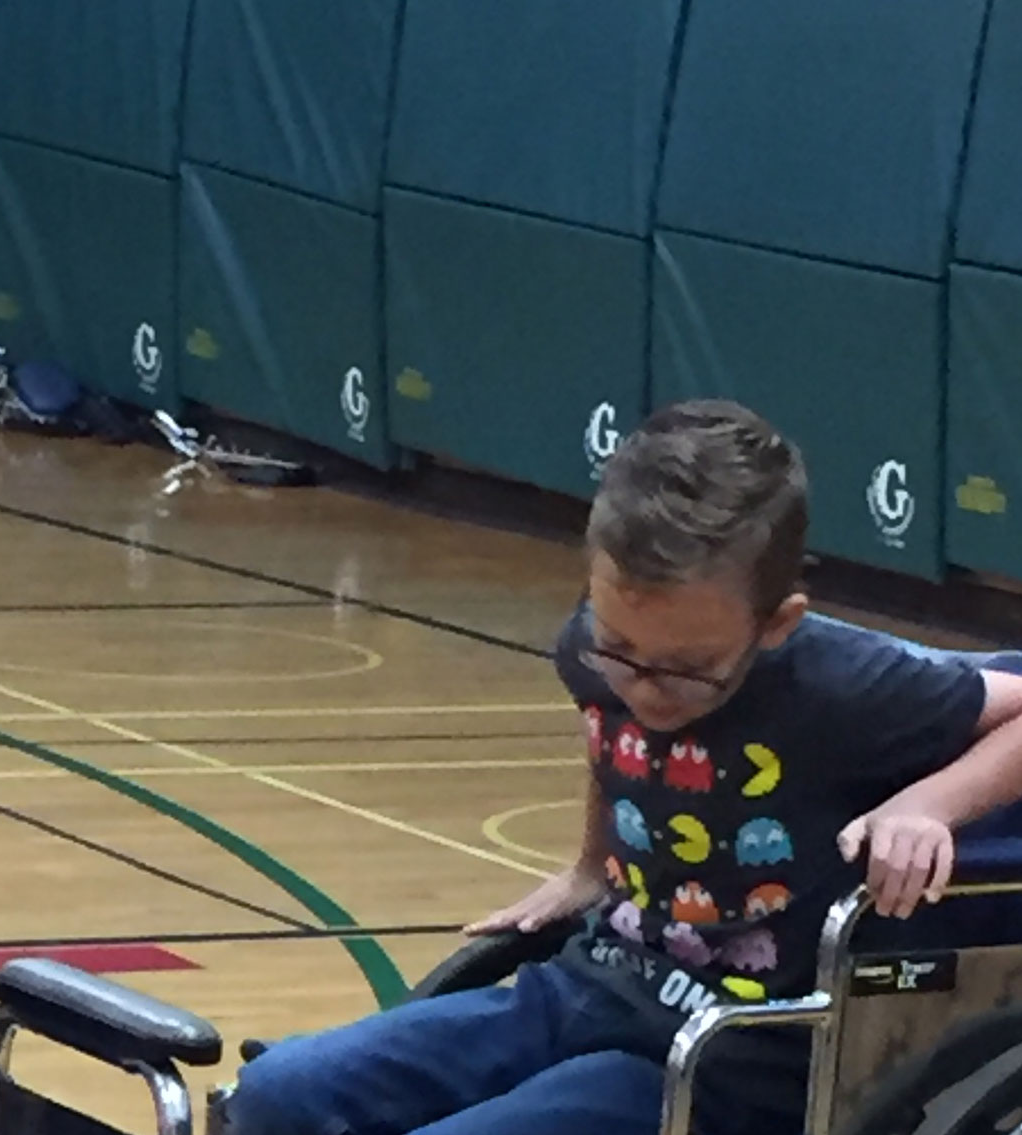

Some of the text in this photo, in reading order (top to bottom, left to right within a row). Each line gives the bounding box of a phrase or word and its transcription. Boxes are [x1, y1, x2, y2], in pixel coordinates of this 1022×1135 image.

[135, 322, 158, 370] G
[589, 401, 619, 458] G
[874, 459, 909, 520] G
